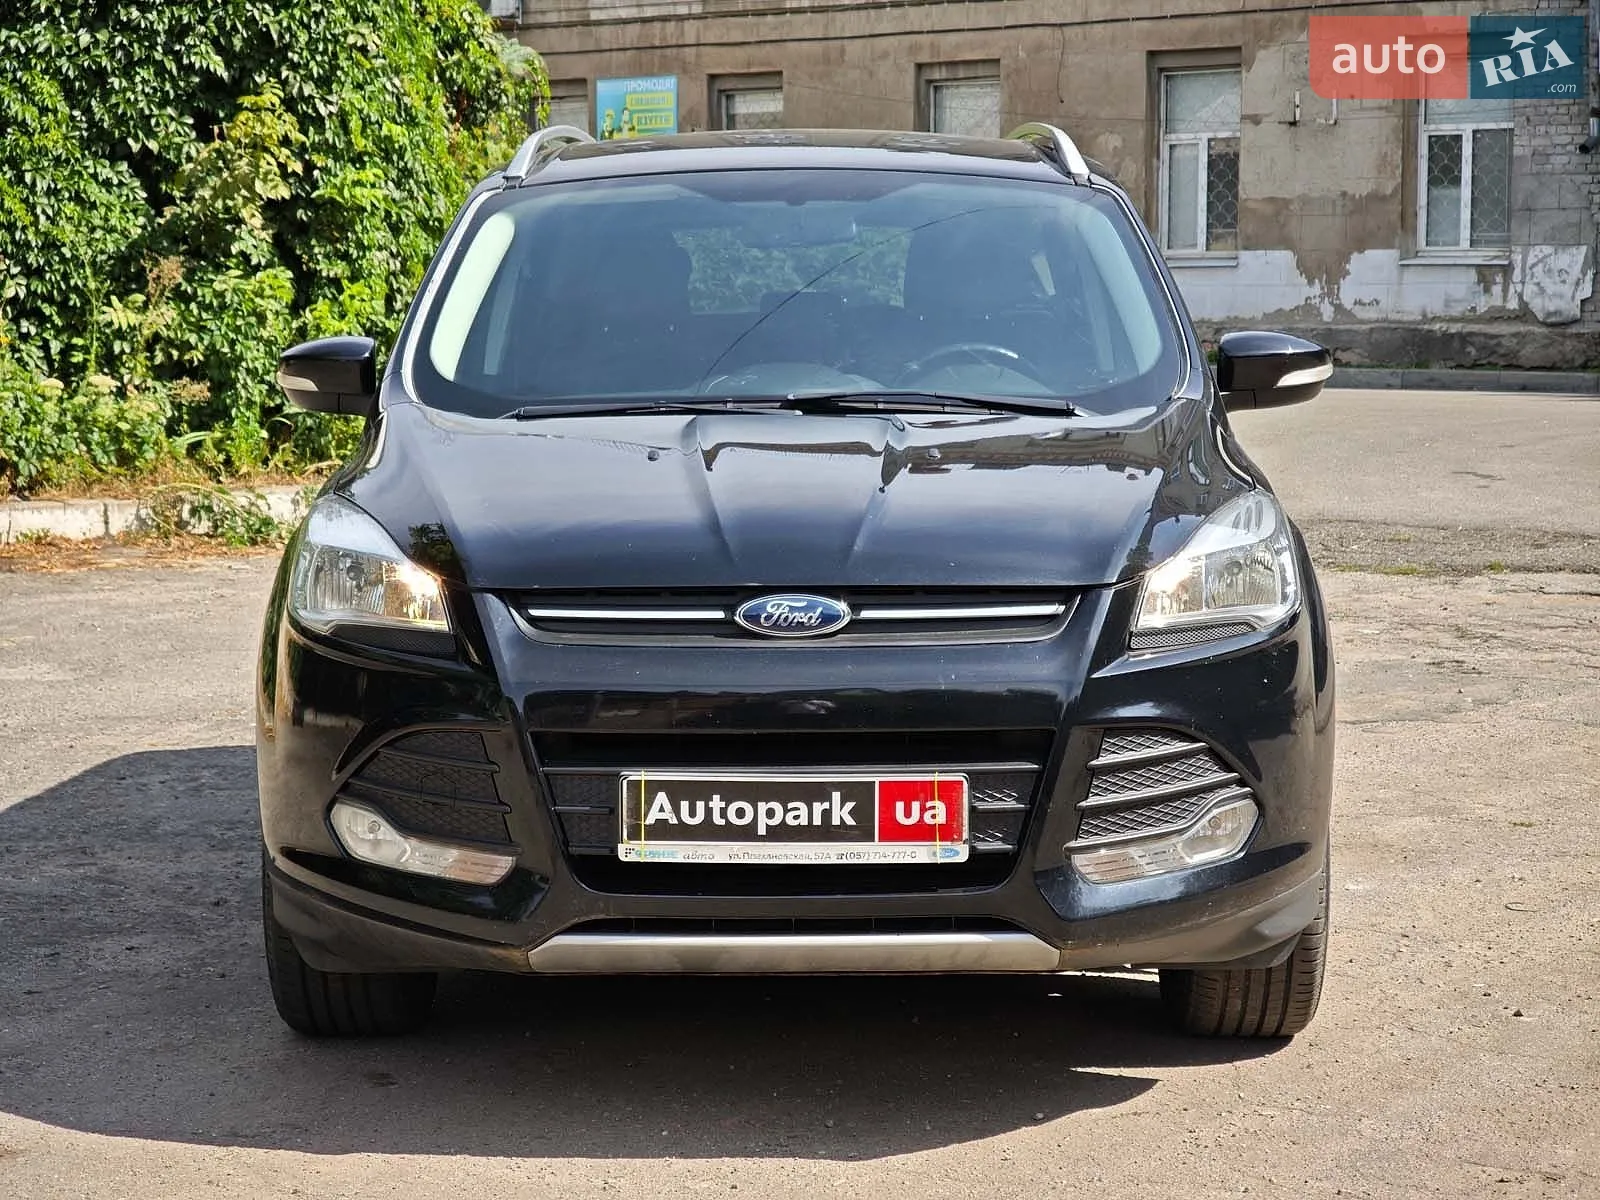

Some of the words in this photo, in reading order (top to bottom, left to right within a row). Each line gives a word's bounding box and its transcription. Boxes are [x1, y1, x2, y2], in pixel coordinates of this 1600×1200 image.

[760, 600, 823, 627] Ford
[645, 791, 857, 836] Autopark
[895, 800, 947, 825] ua
